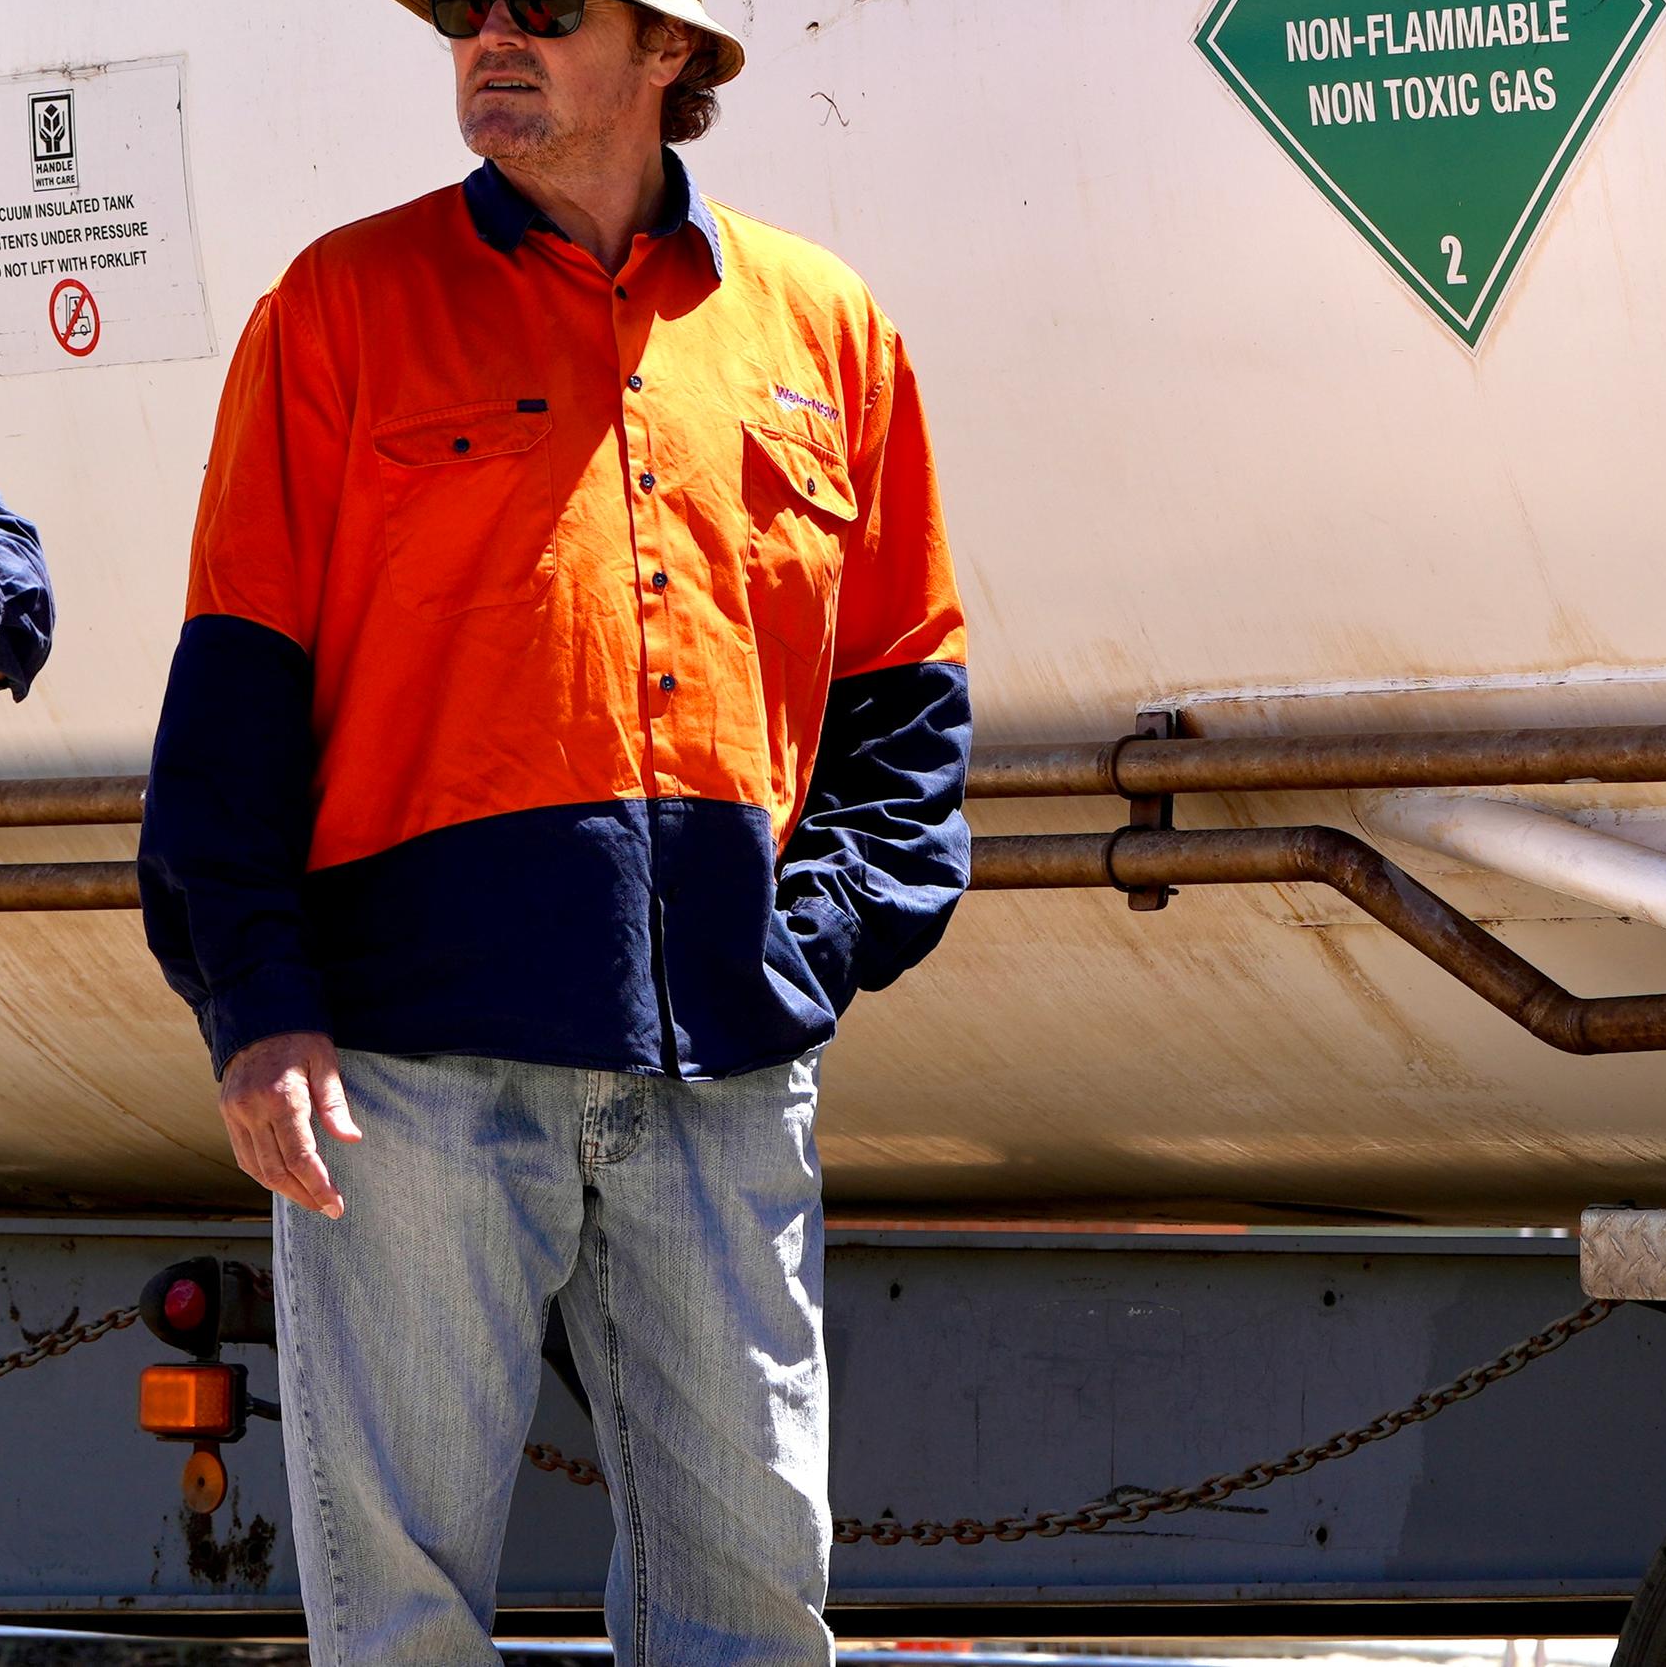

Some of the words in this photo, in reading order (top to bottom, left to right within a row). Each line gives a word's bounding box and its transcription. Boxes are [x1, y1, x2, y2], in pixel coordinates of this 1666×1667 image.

[1286, 0, 1569, 62] NON-FLAMMABLE
[1309, 81, 1375, 125] NON
[1383, 74, 1479, 120] TOXIC
[1490, 68, 1556, 113] GAS
[36, 160, 73, 174] HANDLE
[36, 178, 54, 187] WITH
[56, 175, 75, 185] CARE
[35, 198, 99, 218] INSULATED
[102, 194, 134, 211] TANK
[41, 229, 82, 246] UNDER
[85, 222, 148, 241] PRESSURE
[4, 260, 27, 277] NOT
[31, 260, 54, 275] LIFT
[57, 256, 87, 272] WITH
[91, 250, 147, 269] FORKLIFT
[1441, 236, 1467, 284] 2
